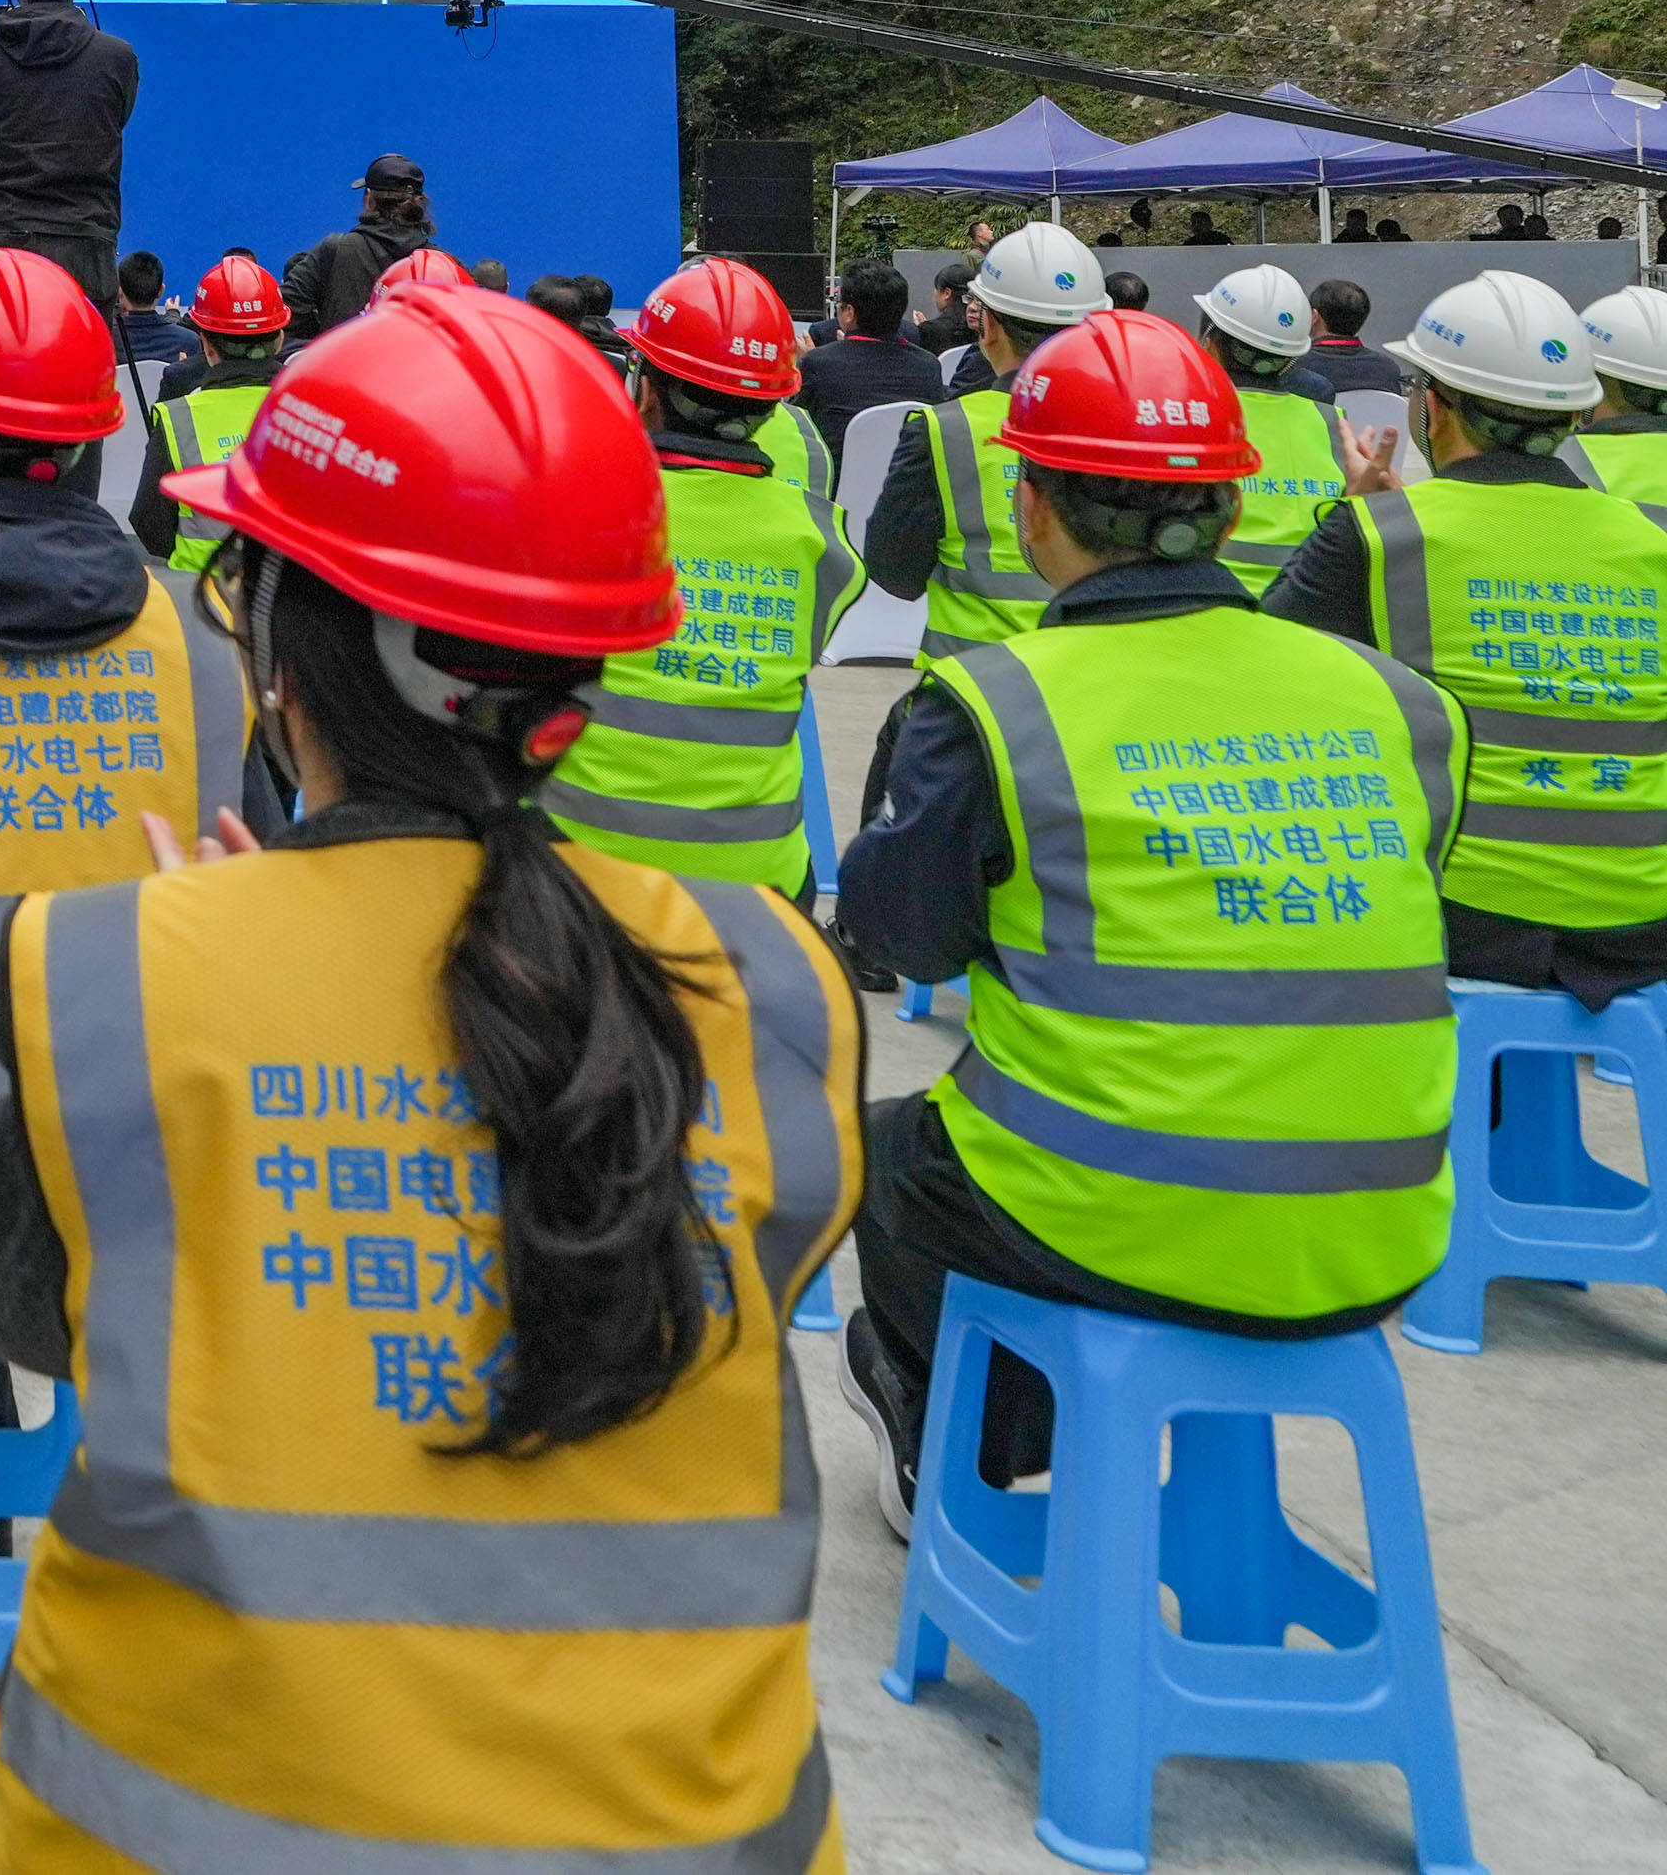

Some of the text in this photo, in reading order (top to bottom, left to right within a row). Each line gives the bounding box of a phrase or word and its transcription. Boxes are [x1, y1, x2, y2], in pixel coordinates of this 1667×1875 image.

[728, 336, 778, 362] 总包部
[1135, 398, 1211, 427] 总包部
[1468, 579, 1658, 609] 四川水发设计公司
[1470, 608, 1660, 641] 中国电建成都院
[654, 648, 762, 689] 联合体
[1472, 639, 1661, 676] 中国水电七局
[1115, 730, 1380, 772] 四川水发设计公司
[1520, 754, 1631, 792] 来宾
[1129, 773, 1394, 817] 中国电建成都院
[1144, 819, 1408, 868] 中国水电七局
[1213, 873, 1371, 925] 联合体
